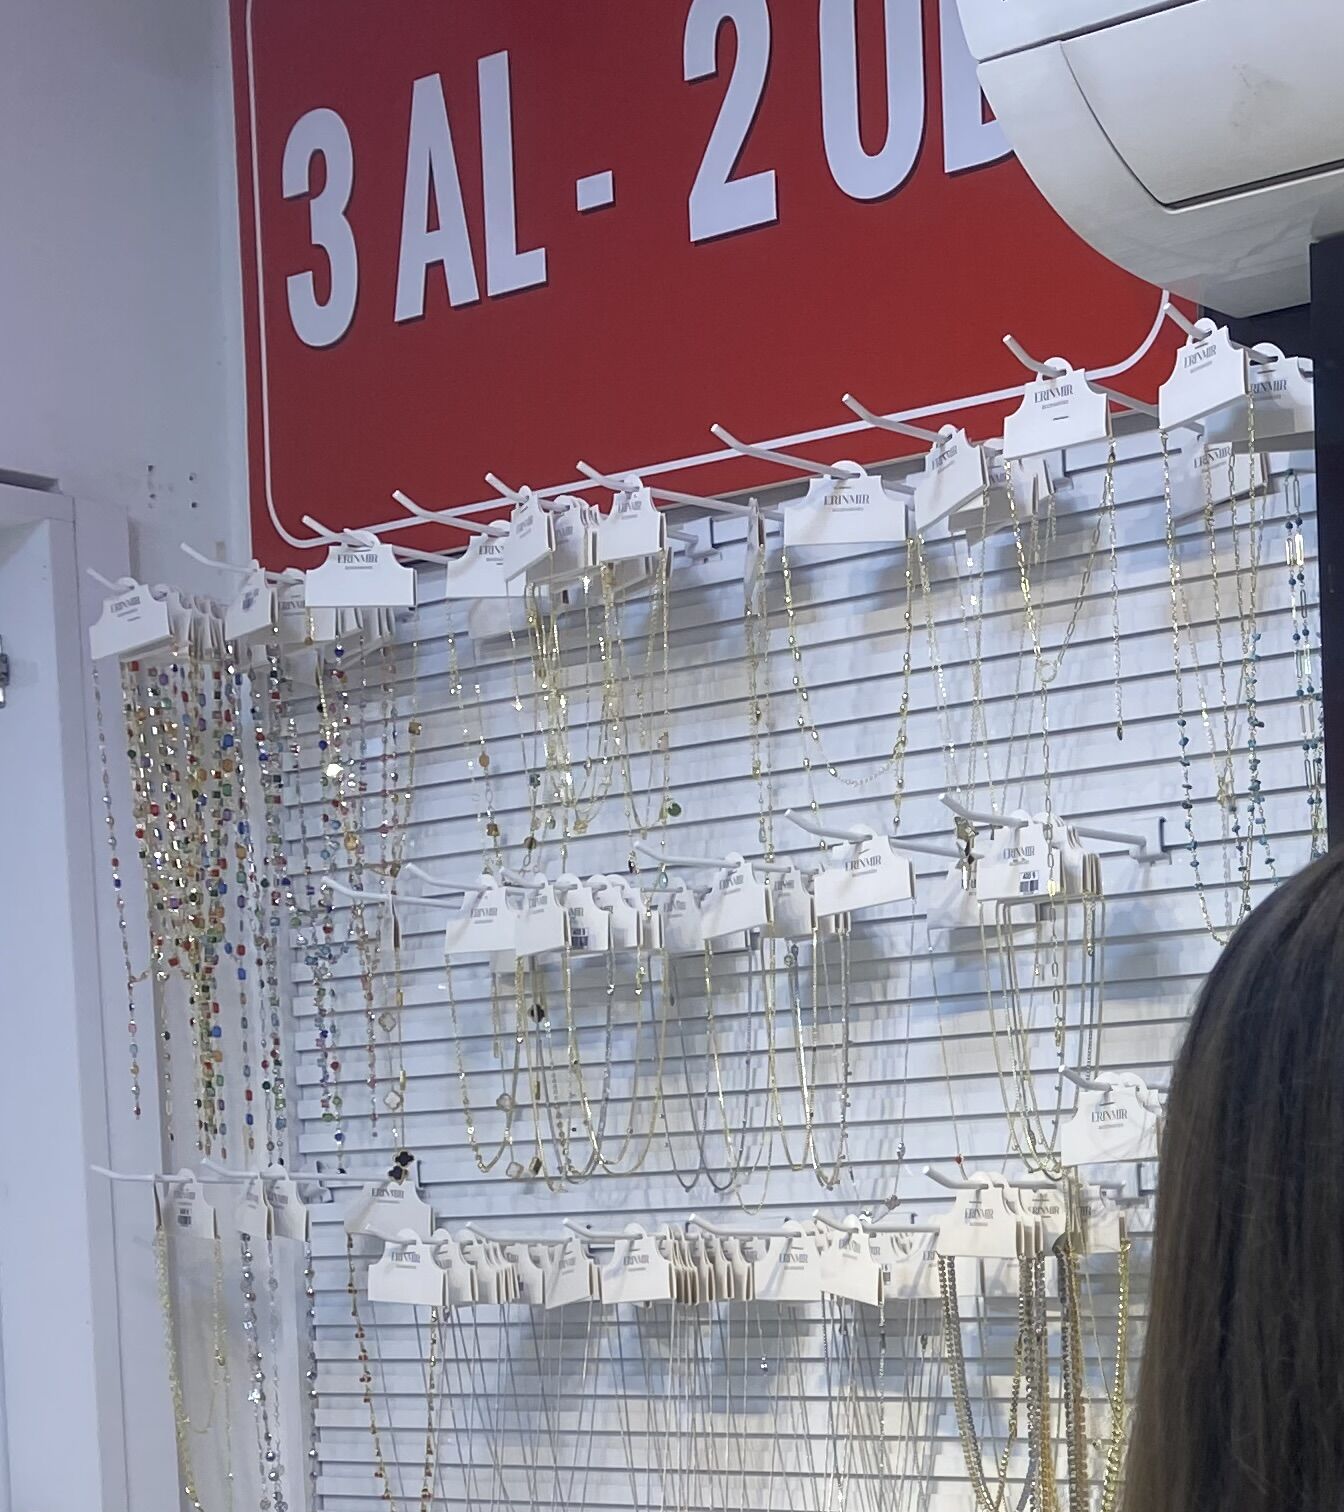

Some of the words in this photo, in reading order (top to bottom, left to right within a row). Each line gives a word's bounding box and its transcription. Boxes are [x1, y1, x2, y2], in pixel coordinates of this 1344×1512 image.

[282, 107, 359, 347] 3
[394, 50, 548, 323] AL
[683, 0, 778, 243] 2
